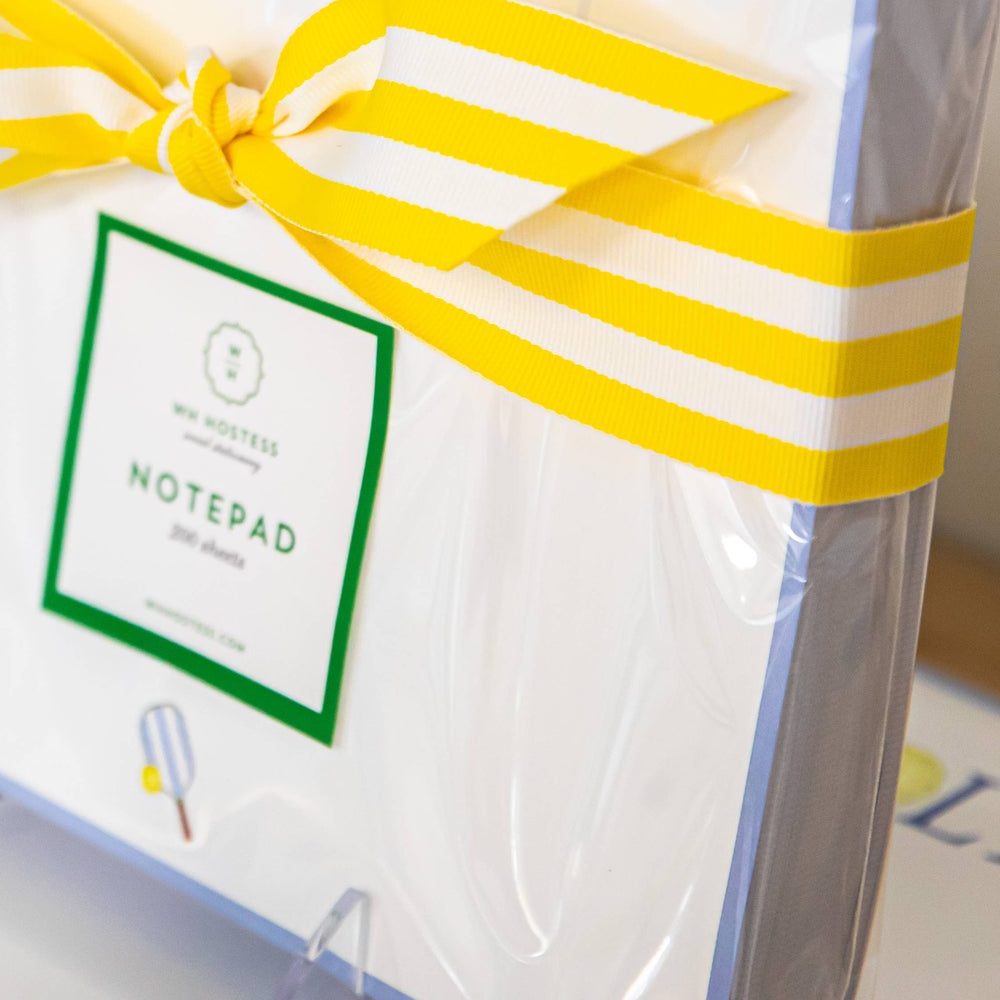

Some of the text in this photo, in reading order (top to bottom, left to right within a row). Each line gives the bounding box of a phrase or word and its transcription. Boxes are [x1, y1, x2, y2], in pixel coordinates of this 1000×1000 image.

[204, 416, 279, 458] HOSTESS
[128, 460, 297, 554] NOTEPAD
[200, 539, 246, 571] sheets
